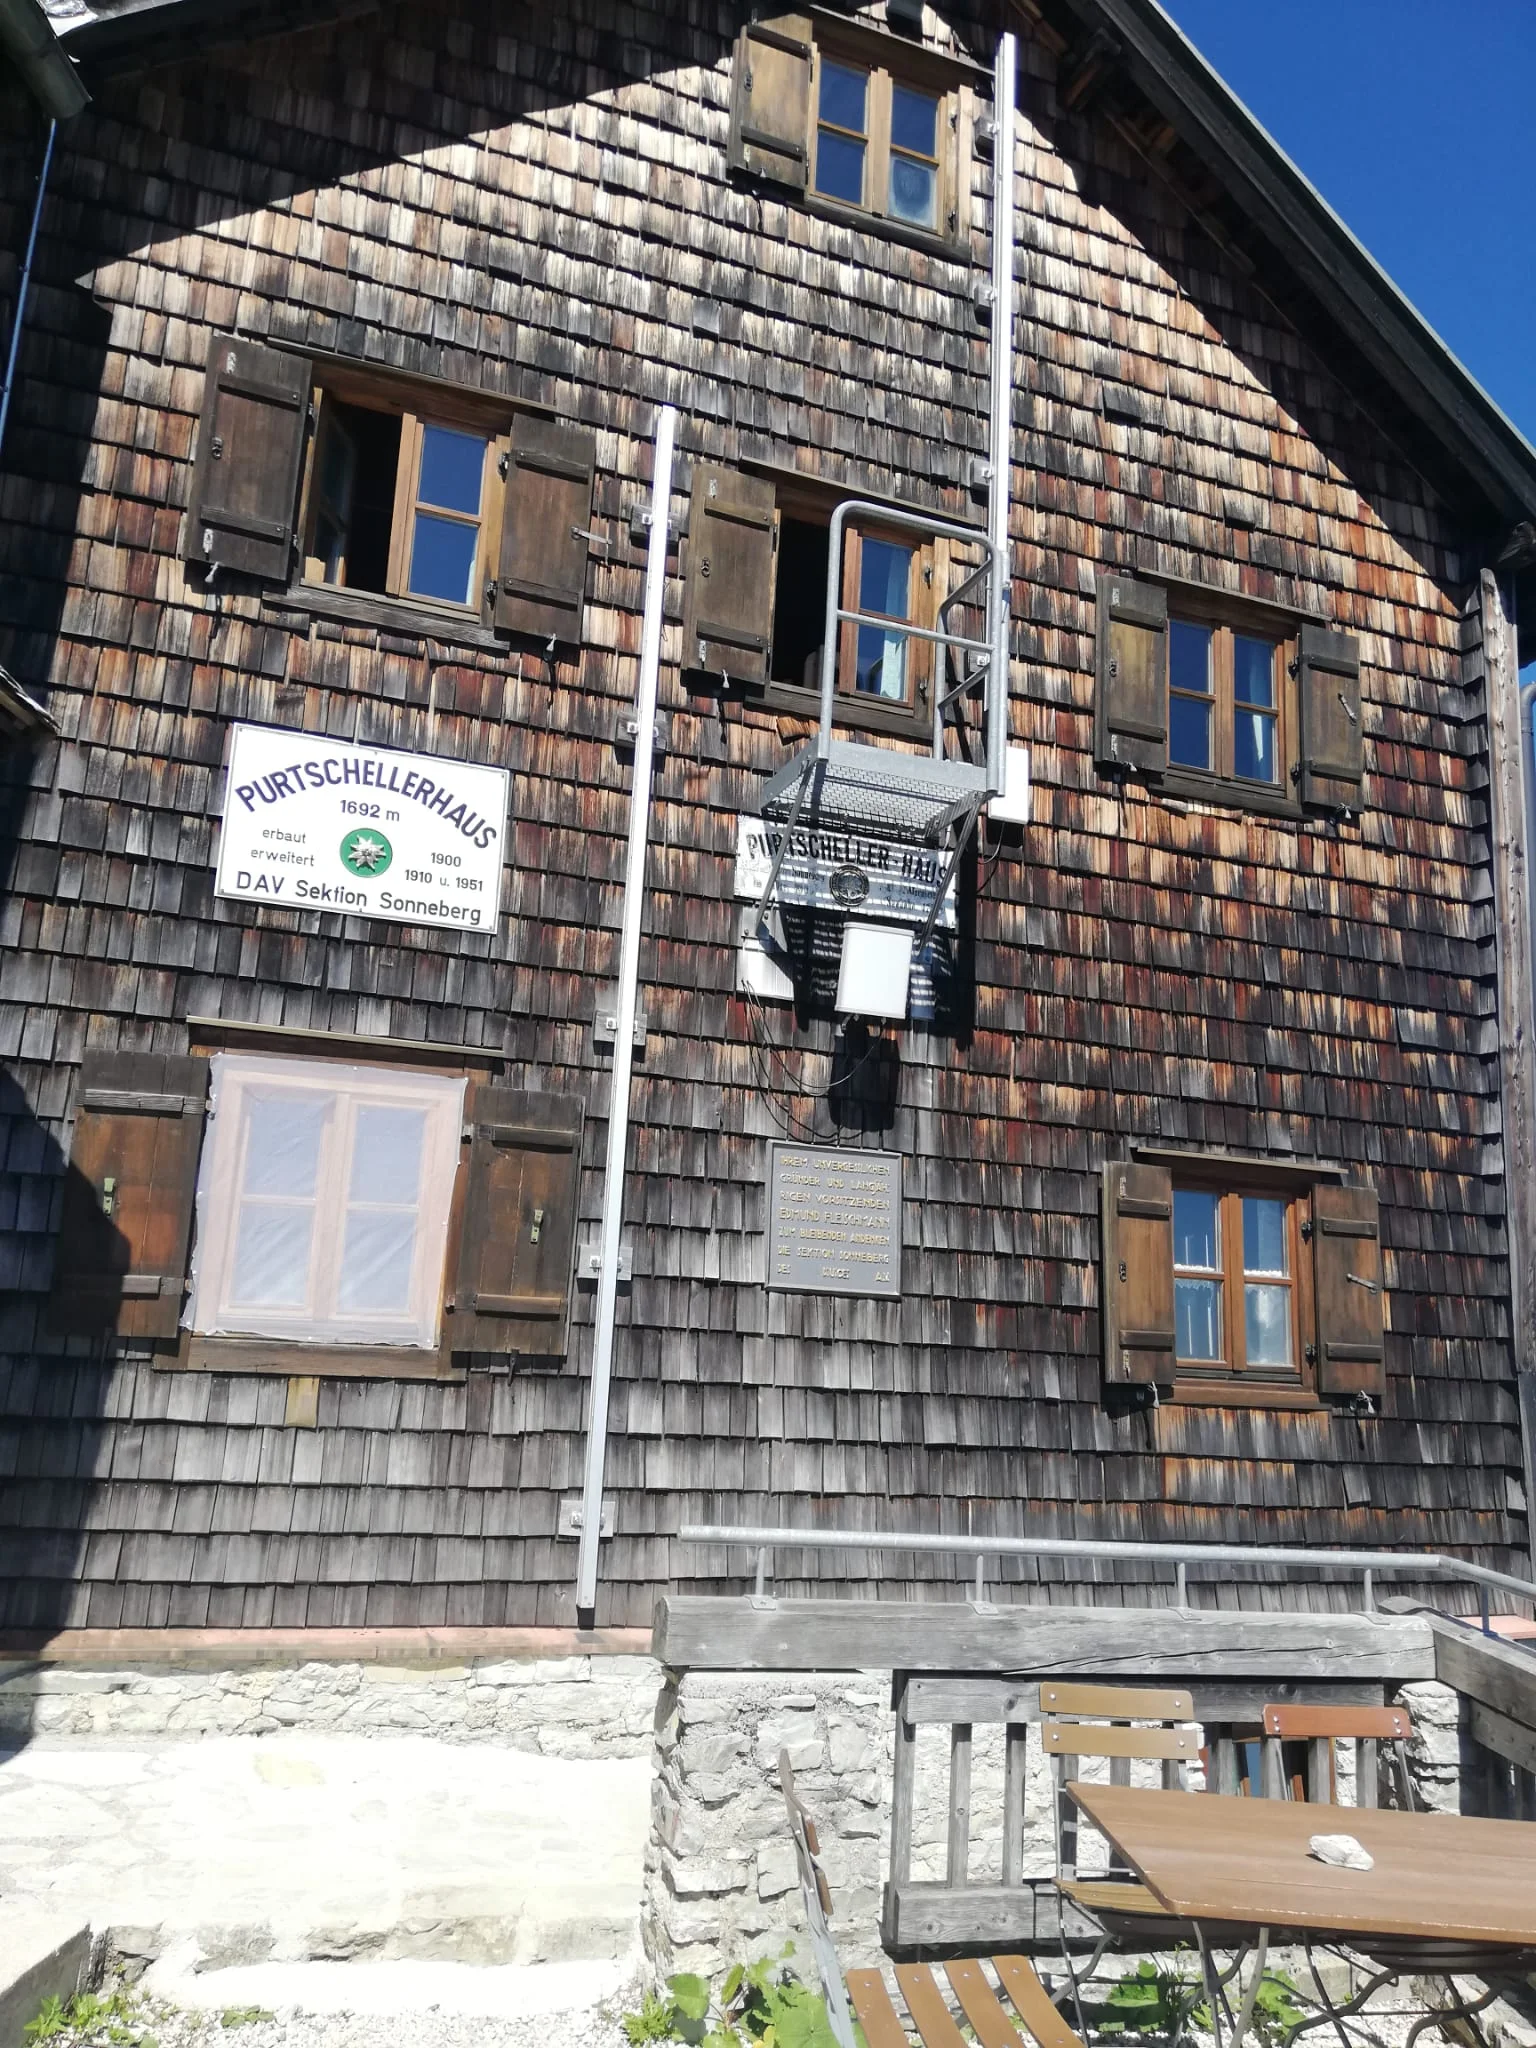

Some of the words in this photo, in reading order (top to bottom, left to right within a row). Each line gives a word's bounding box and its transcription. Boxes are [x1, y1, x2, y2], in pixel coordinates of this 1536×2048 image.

[235, 758, 497, 849] PURTSCHELLERHAUS
[340, 799, 381, 818] 1692
[386, 809, 400, 822] m
[262, 828, 307, 843] erbaut
[430, 852, 462, 868] 1900
[250, 848, 315, 867] erweitert
[405, 869, 433, 884] 1910
[440, 876, 450, 888] u.
[455, 877, 483, 892] 1951
[236, 871, 285, 894] DAV
[295, 879, 367, 906] Sektion
[380, 892, 481, 925] Sonneberg
[780, 1155, 808, 1168] IHREM
[780, 1171, 821, 1187] GRÜNDER
[827, 1177, 845, 1189] UND
[815, 1193, 890, 1210] VORSITZENDEN
[779, 1207, 820, 1223] EDMUND
[824, 1212, 890, 1229] FLEISCHMANN
[799, 1227, 848, 1243] BLEIBENDEN
[850, 1232, 890, 1247] ANDENKEN
[778, 1244, 791, 1256] DIE
[797, 1246, 835, 1260] SEKTION
[839, 1249, 889, 1264] SONNEBERG
